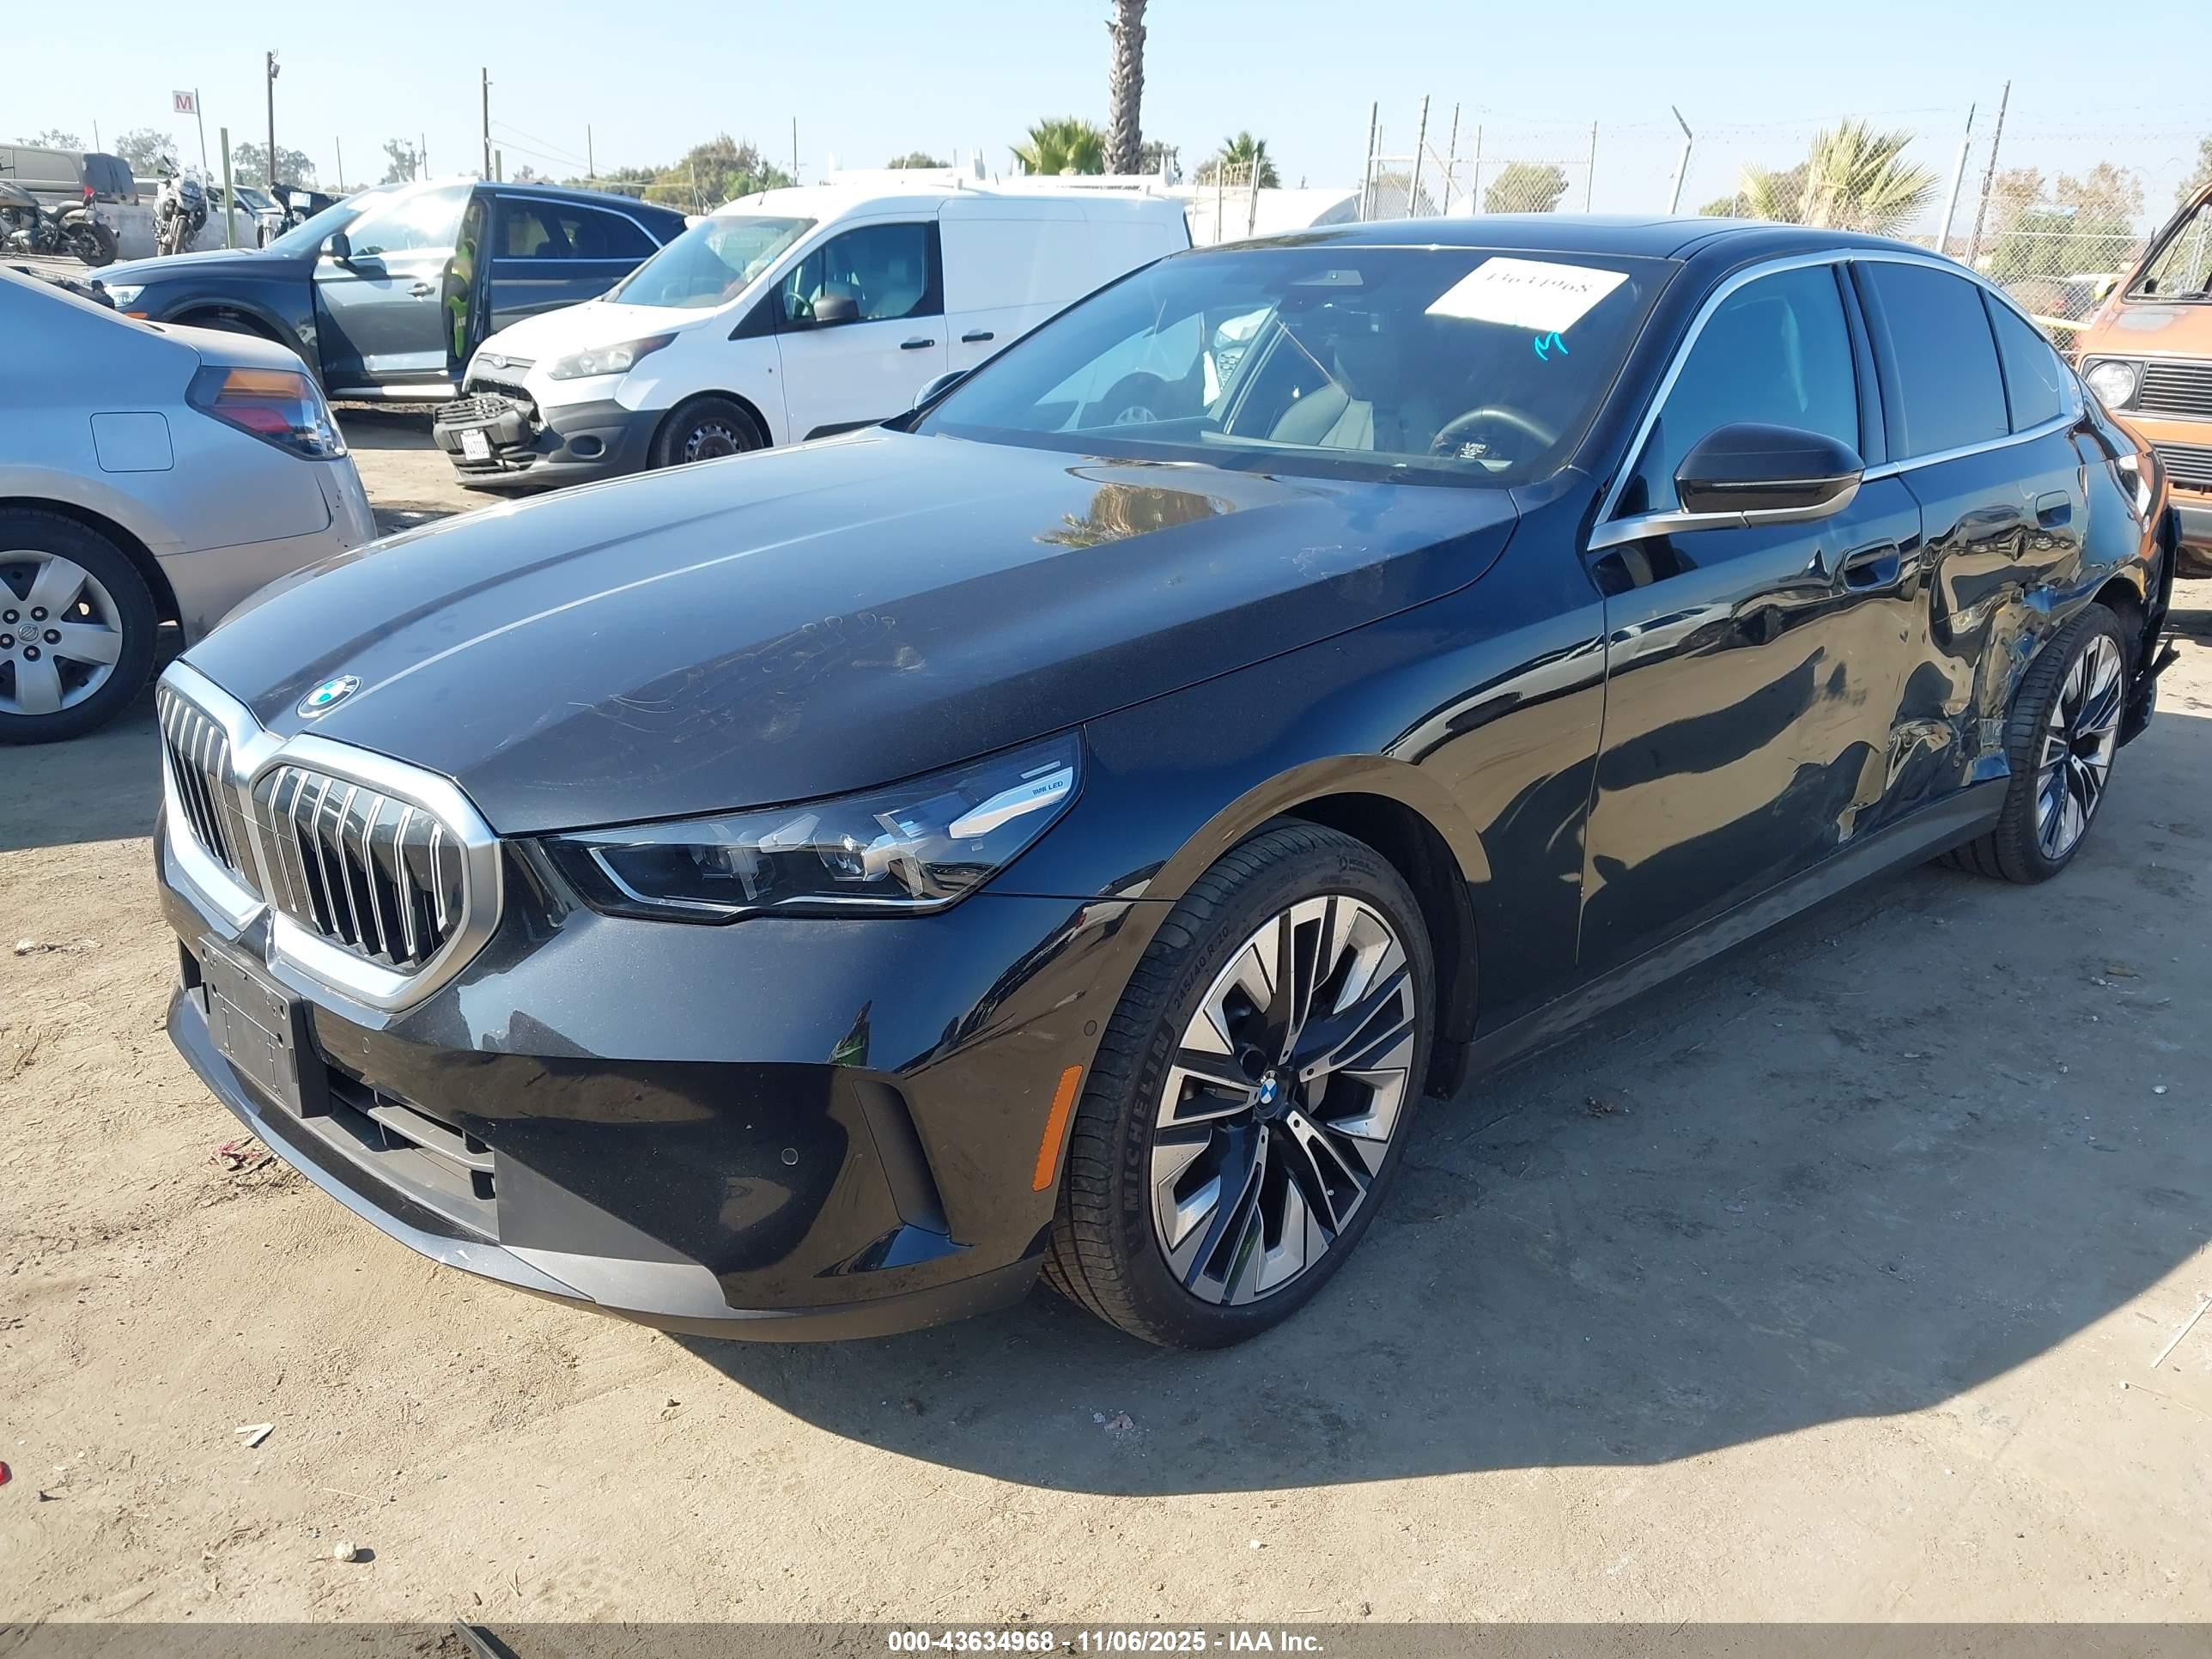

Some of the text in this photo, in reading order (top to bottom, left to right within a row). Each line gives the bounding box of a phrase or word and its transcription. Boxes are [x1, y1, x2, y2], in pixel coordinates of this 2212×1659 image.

[175, 94, 192, 110] M
[1032, 781, 1064, 795] BMW LED
[1216, 927, 1230, 945] 20
[1122, 1031, 1170, 1212] MICHELIN
